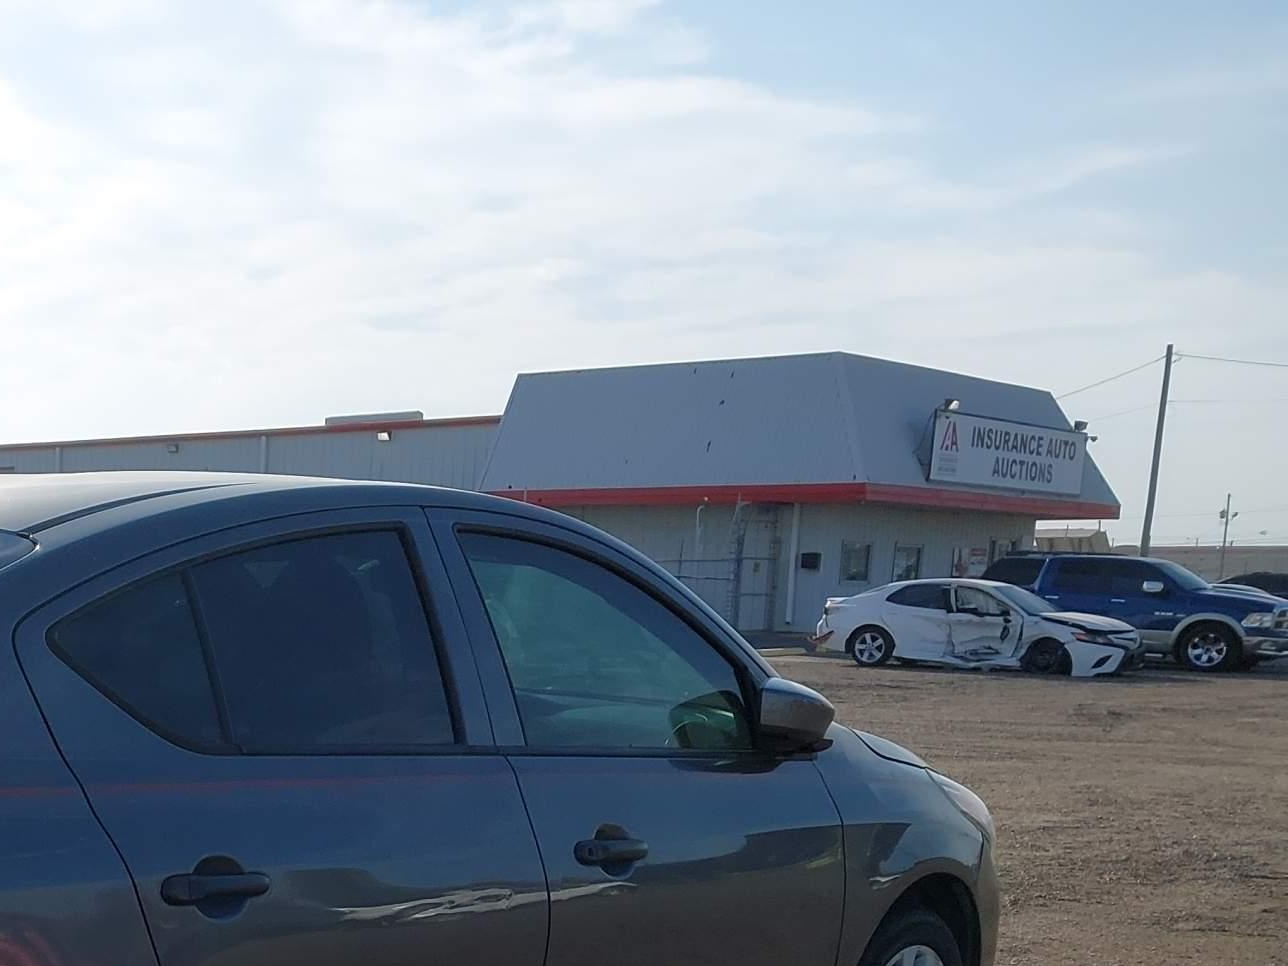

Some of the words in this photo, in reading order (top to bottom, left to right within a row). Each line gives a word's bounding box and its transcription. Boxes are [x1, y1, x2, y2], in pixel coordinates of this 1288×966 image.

[971, 426, 1044, 456] INSURANCE
[1045, 438, 1077, 461] AUTO
[992, 456, 1054, 484] AUCTIONS
